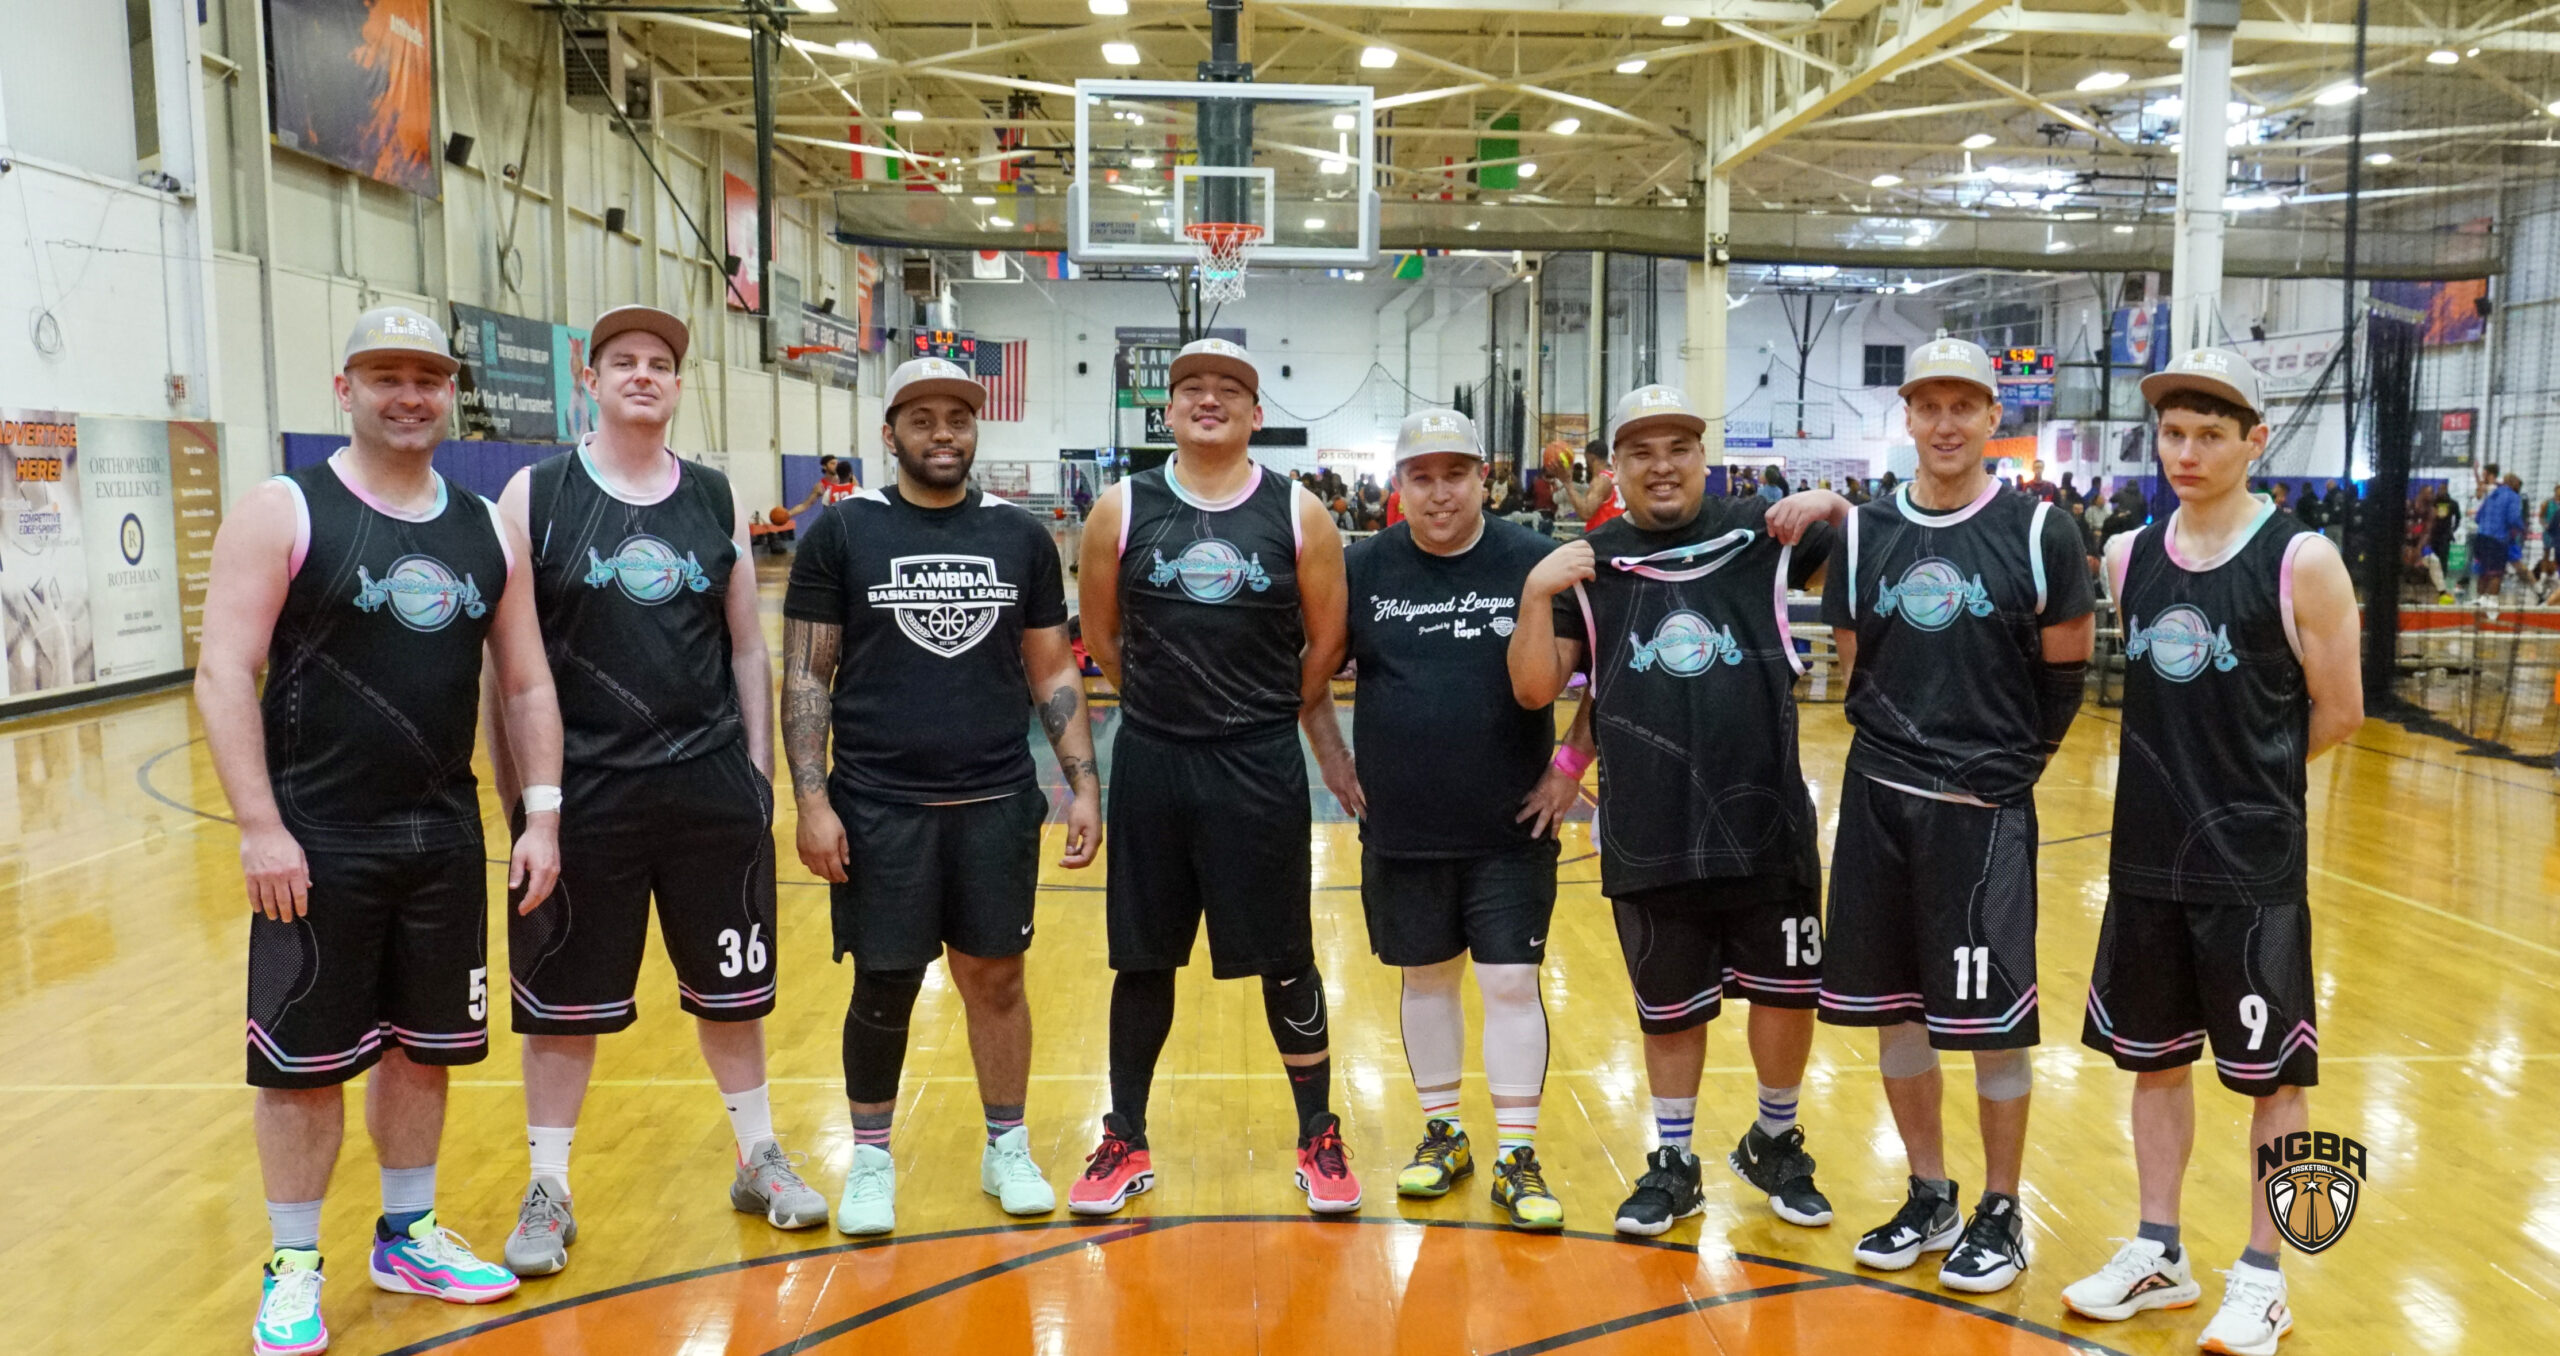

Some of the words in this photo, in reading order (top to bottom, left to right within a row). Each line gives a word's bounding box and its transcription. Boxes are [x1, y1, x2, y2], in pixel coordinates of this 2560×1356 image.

[1128, 346, 1171, 366] SLAM
[16, 457, 62, 482] HERE!
[89, 456, 164, 475] ORTHOPAEDIC
[96, 479, 161, 498] EXCELLENCE
[19, 512, 61, 524] COMPETITIVE
[128, 530, 137, 548] R
[107, 568, 161, 587] ROTHMAN
[901, 571, 990, 589] LAMBDA
[867, 589, 965, 603] BASKETBALL
[968, 588, 1020, 601] LEAGUE
[1374, 596, 1456, 622] Hollywood
[1457, 591, 1516, 614] League
[1454, 618, 1466, 629] hi
[1454, 626, 1481, 639] tops
[717, 923, 767, 977] 36
[1781, 916, 1823, 967] 13
[1953, 946, 1989, 1000] 11
[468, 965, 487, 1021] 5
[2238, 994, 2268, 1050] 9
